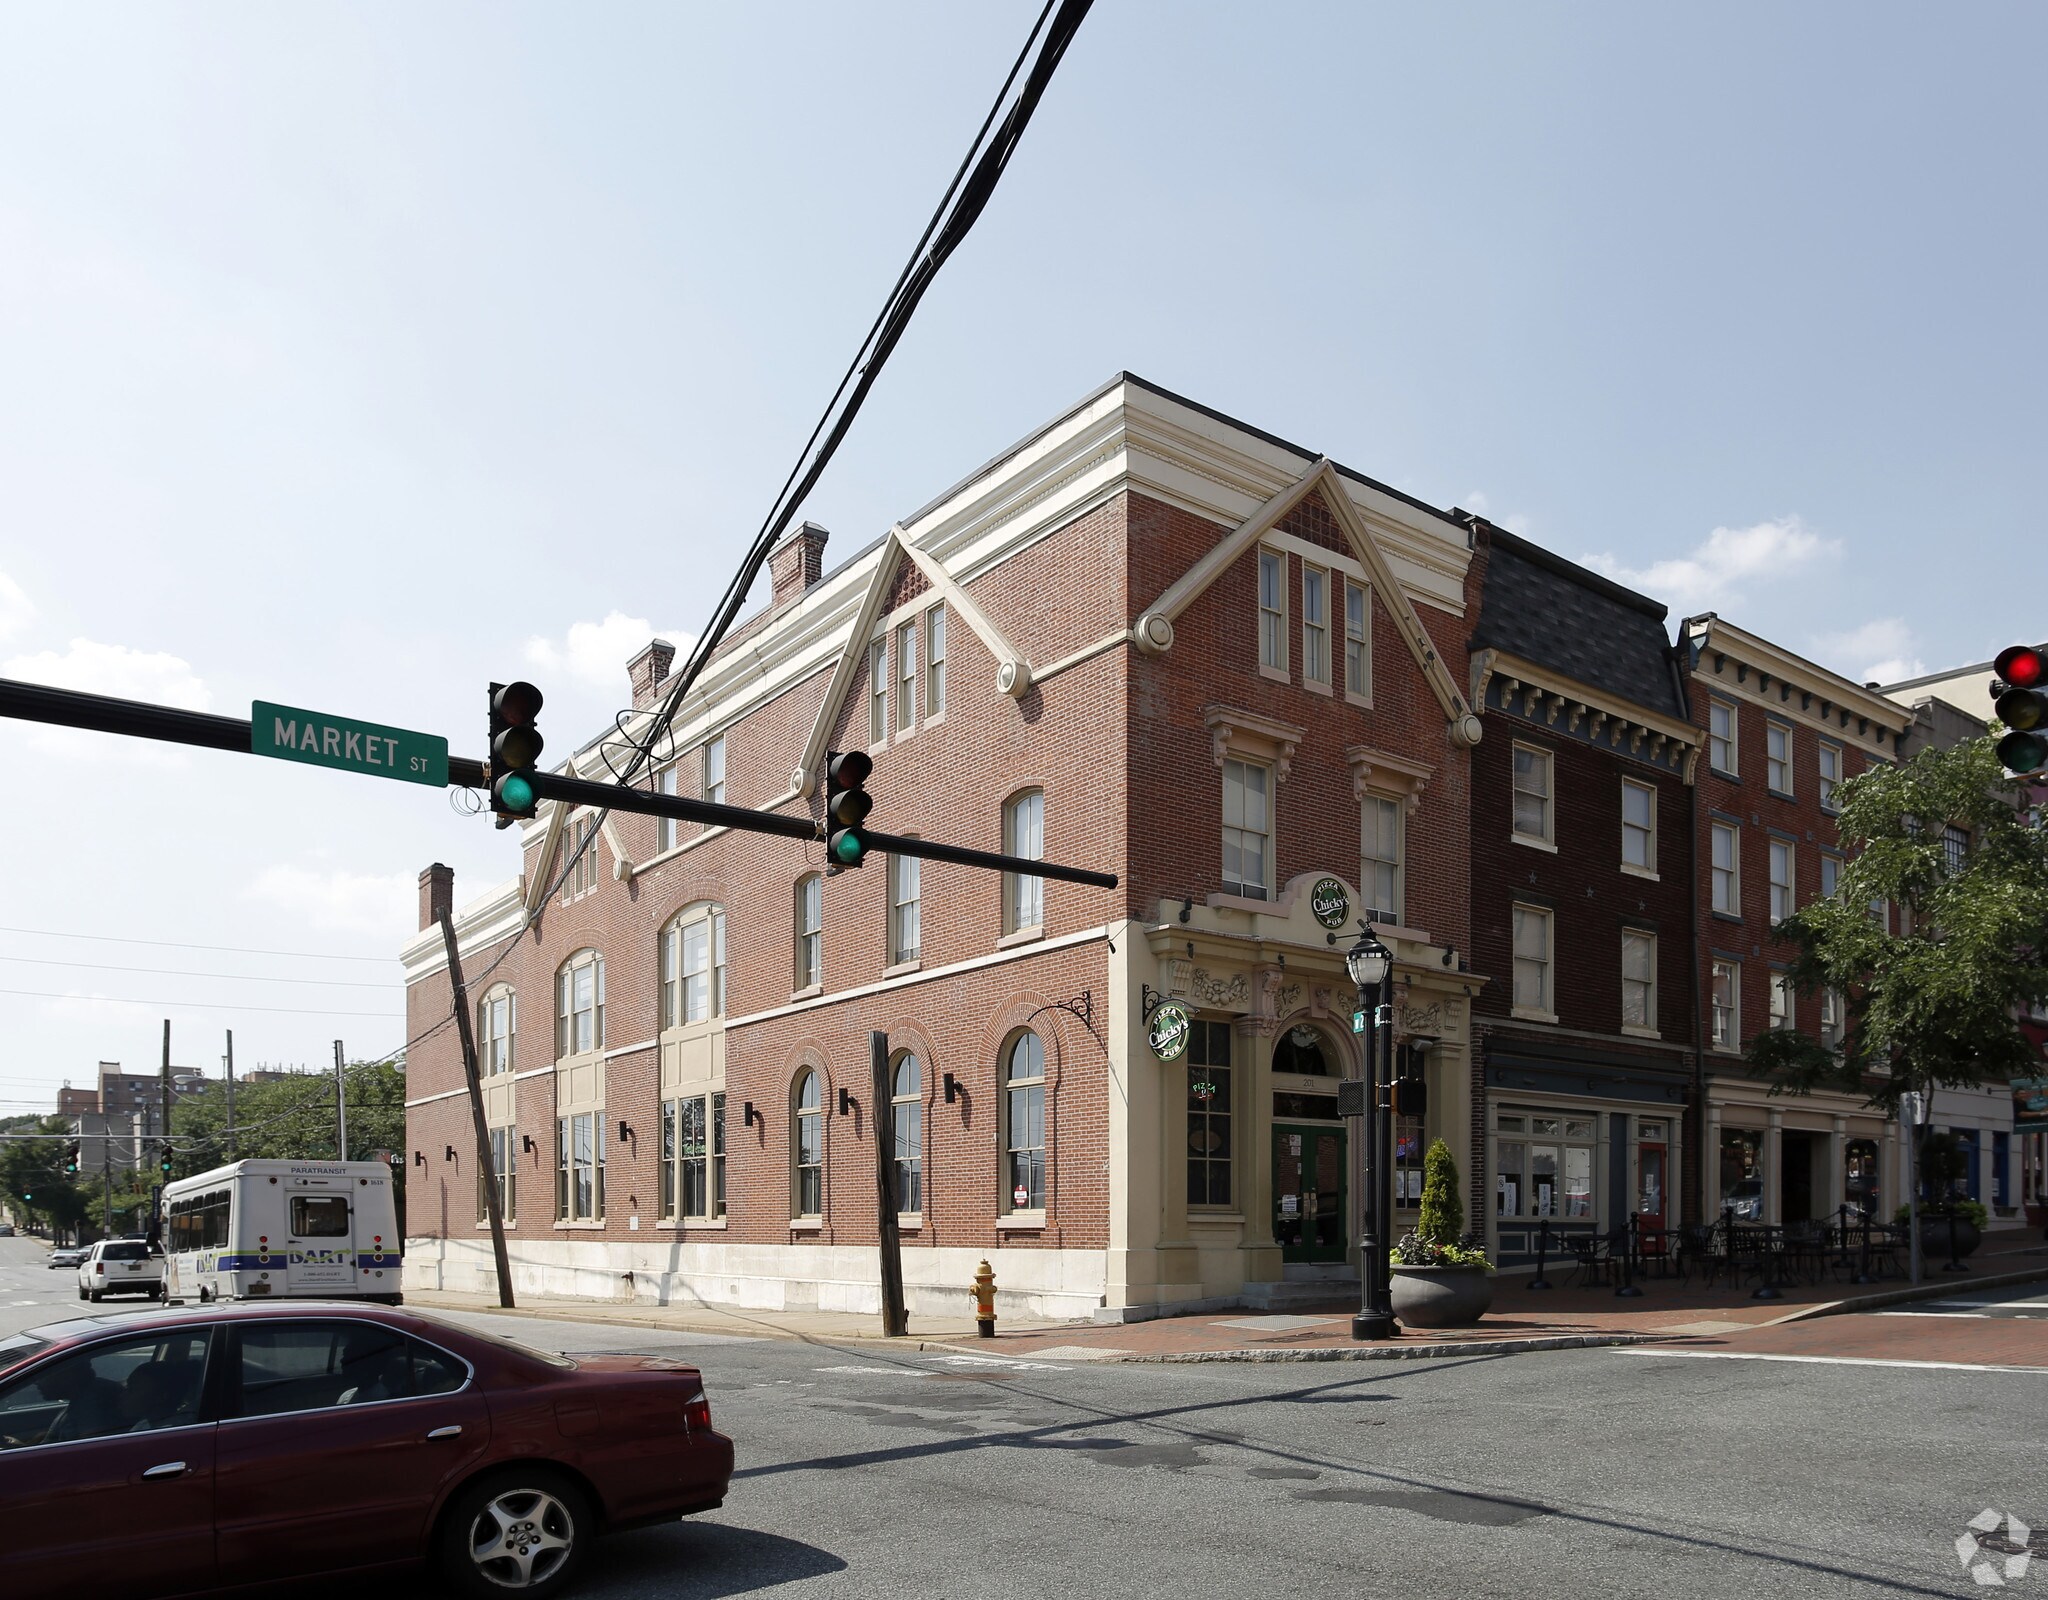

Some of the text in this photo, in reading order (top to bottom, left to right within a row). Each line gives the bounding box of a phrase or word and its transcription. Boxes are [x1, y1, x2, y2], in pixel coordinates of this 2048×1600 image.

[274, 717, 428, 773] MARKET ST
[1317, 881, 1339, 893] PIZZA
[1313, 896, 1350, 912] Chicky's
[1326, 917, 1343, 926] PUB
[1154, 1007, 1177, 1025] PIZZA
[1148, 1018, 1189, 1047] Chicky's
[1162, 1044, 1181, 1057] PUB
[1303, 1078, 1314, 1087] 201
[290, 1167, 347, 1175] PARATRANSIT
[289, 1249, 349, 1264] DART
